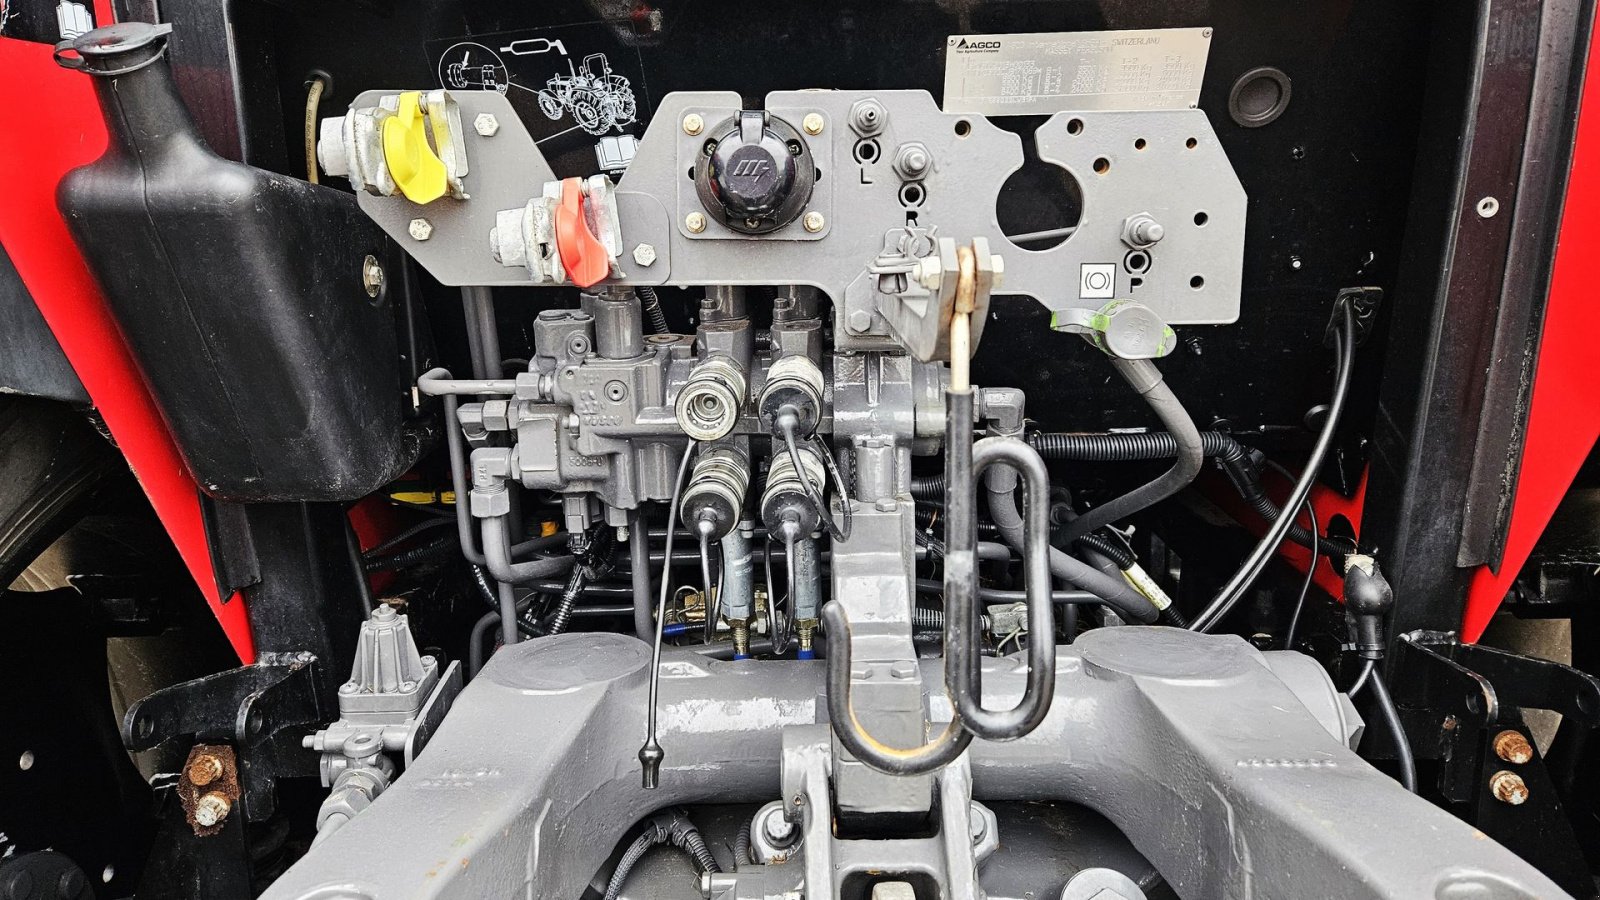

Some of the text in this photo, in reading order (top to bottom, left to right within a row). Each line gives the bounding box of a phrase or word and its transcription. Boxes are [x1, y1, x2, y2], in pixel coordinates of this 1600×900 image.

[969, 41, 1001, 49] AGCO
[861, 168, 873, 184] L
[906, 211, 919, 227] R
[1130, 278, 1143, 293] P
